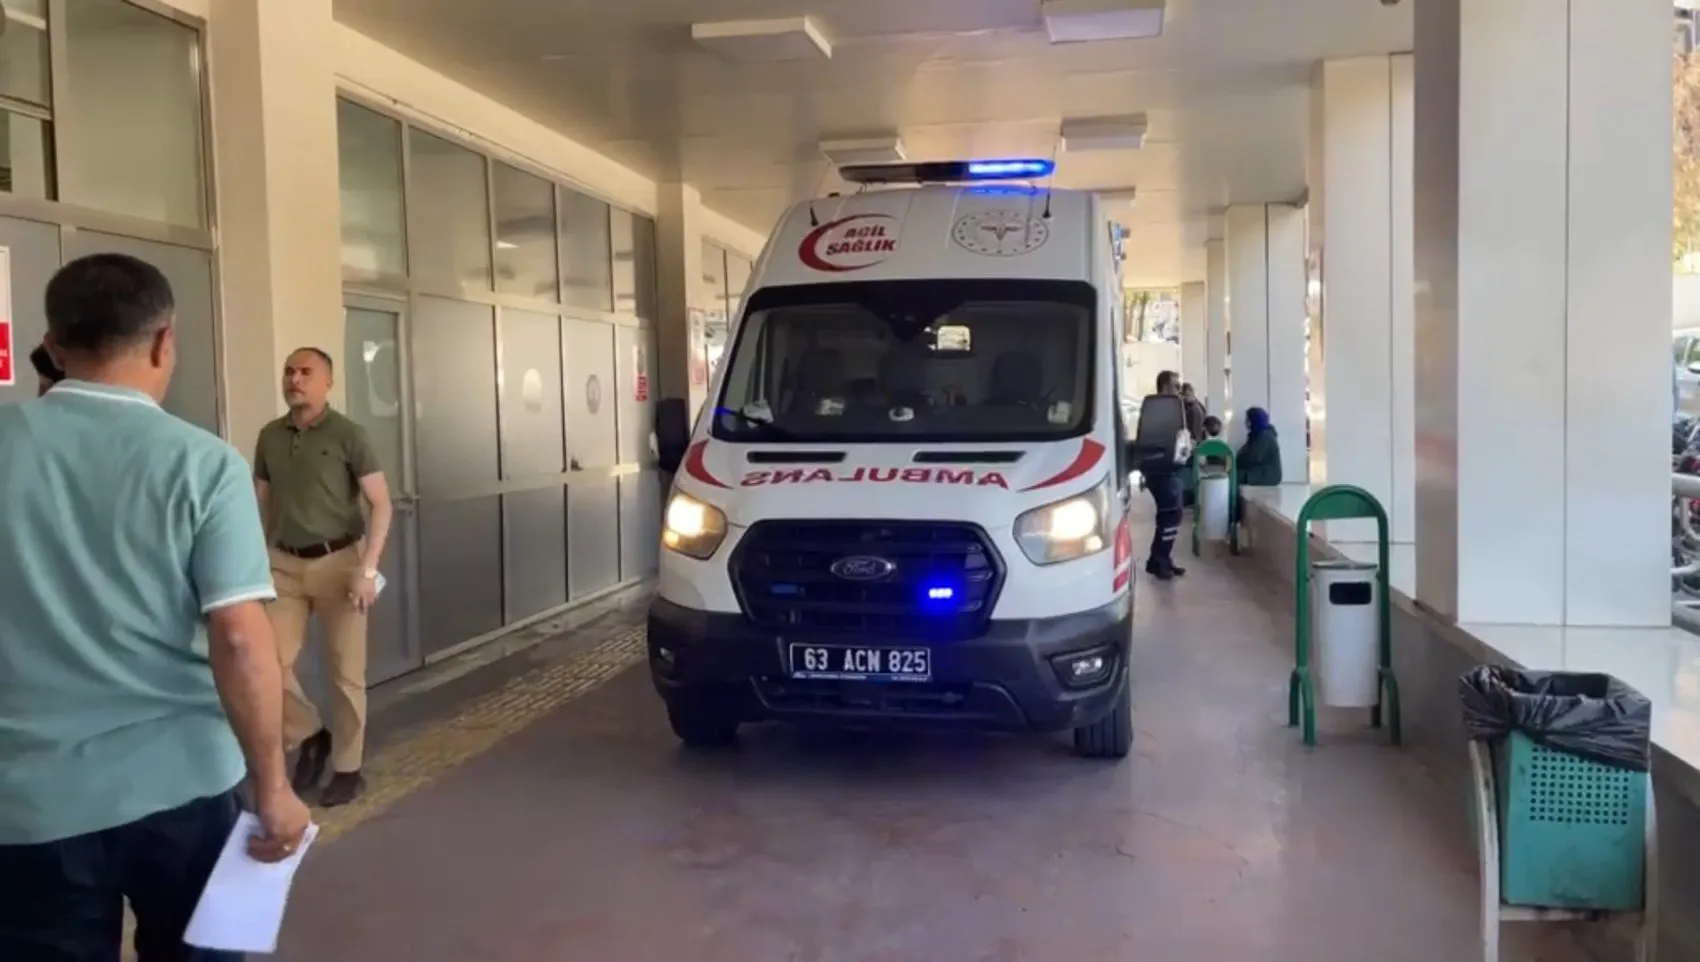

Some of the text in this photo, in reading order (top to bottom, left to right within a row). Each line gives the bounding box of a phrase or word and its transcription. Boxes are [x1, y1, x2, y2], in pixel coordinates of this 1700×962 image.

[842, 561, 876, 576] Ford
[804, 648, 926, 673] 63 ACN 825
